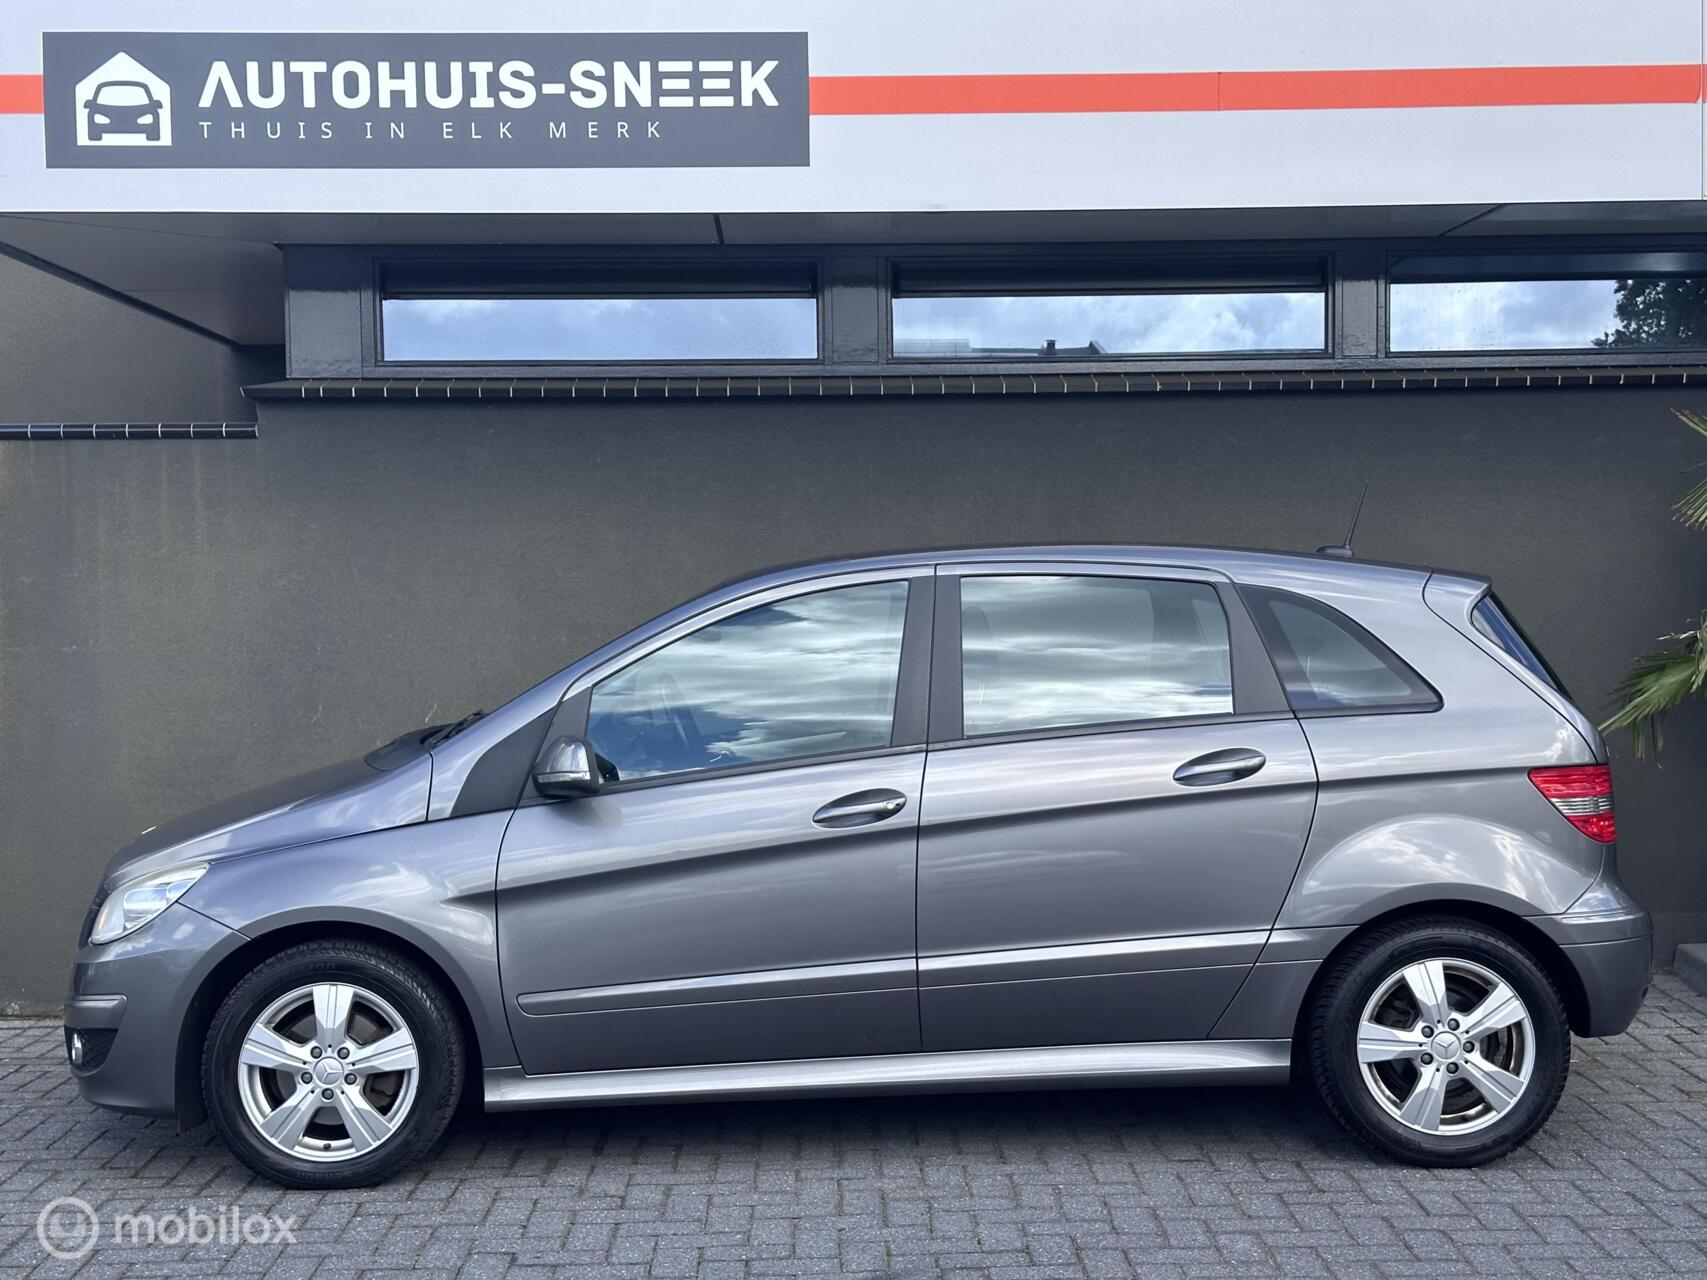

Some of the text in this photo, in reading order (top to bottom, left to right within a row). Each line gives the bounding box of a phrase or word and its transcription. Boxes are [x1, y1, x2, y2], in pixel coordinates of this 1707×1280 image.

[197, 59, 780, 110] AUTOHUIS-SNEEK
[198, 120, 662, 140] THUIS IN ELK MERK
